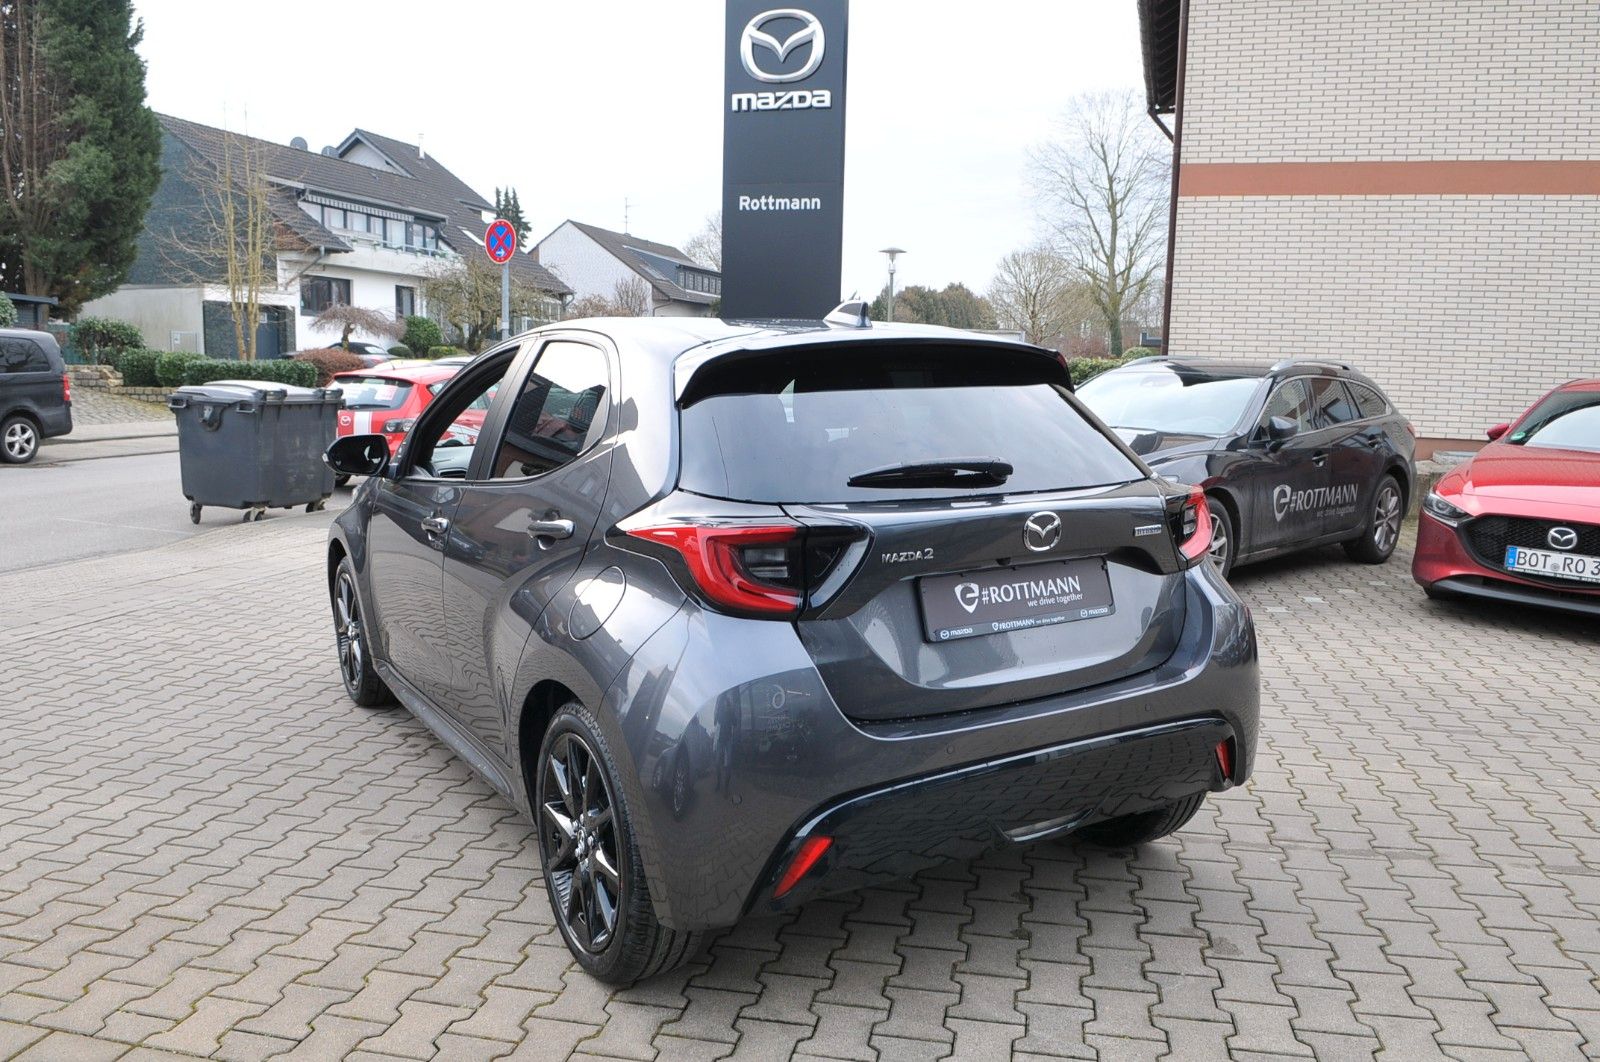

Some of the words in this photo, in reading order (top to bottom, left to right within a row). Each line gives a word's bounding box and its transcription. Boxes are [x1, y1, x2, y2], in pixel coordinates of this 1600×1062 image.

[732, 89, 831, 112] mazda
[739, 195, 821, 211] Rottmann
[1517, 550, 1551, 569] BOT
[1562, 556, 1586, 574] RO
[1040, 597, 1056, 605] drive
[1056, 593, 1083, 604] together
